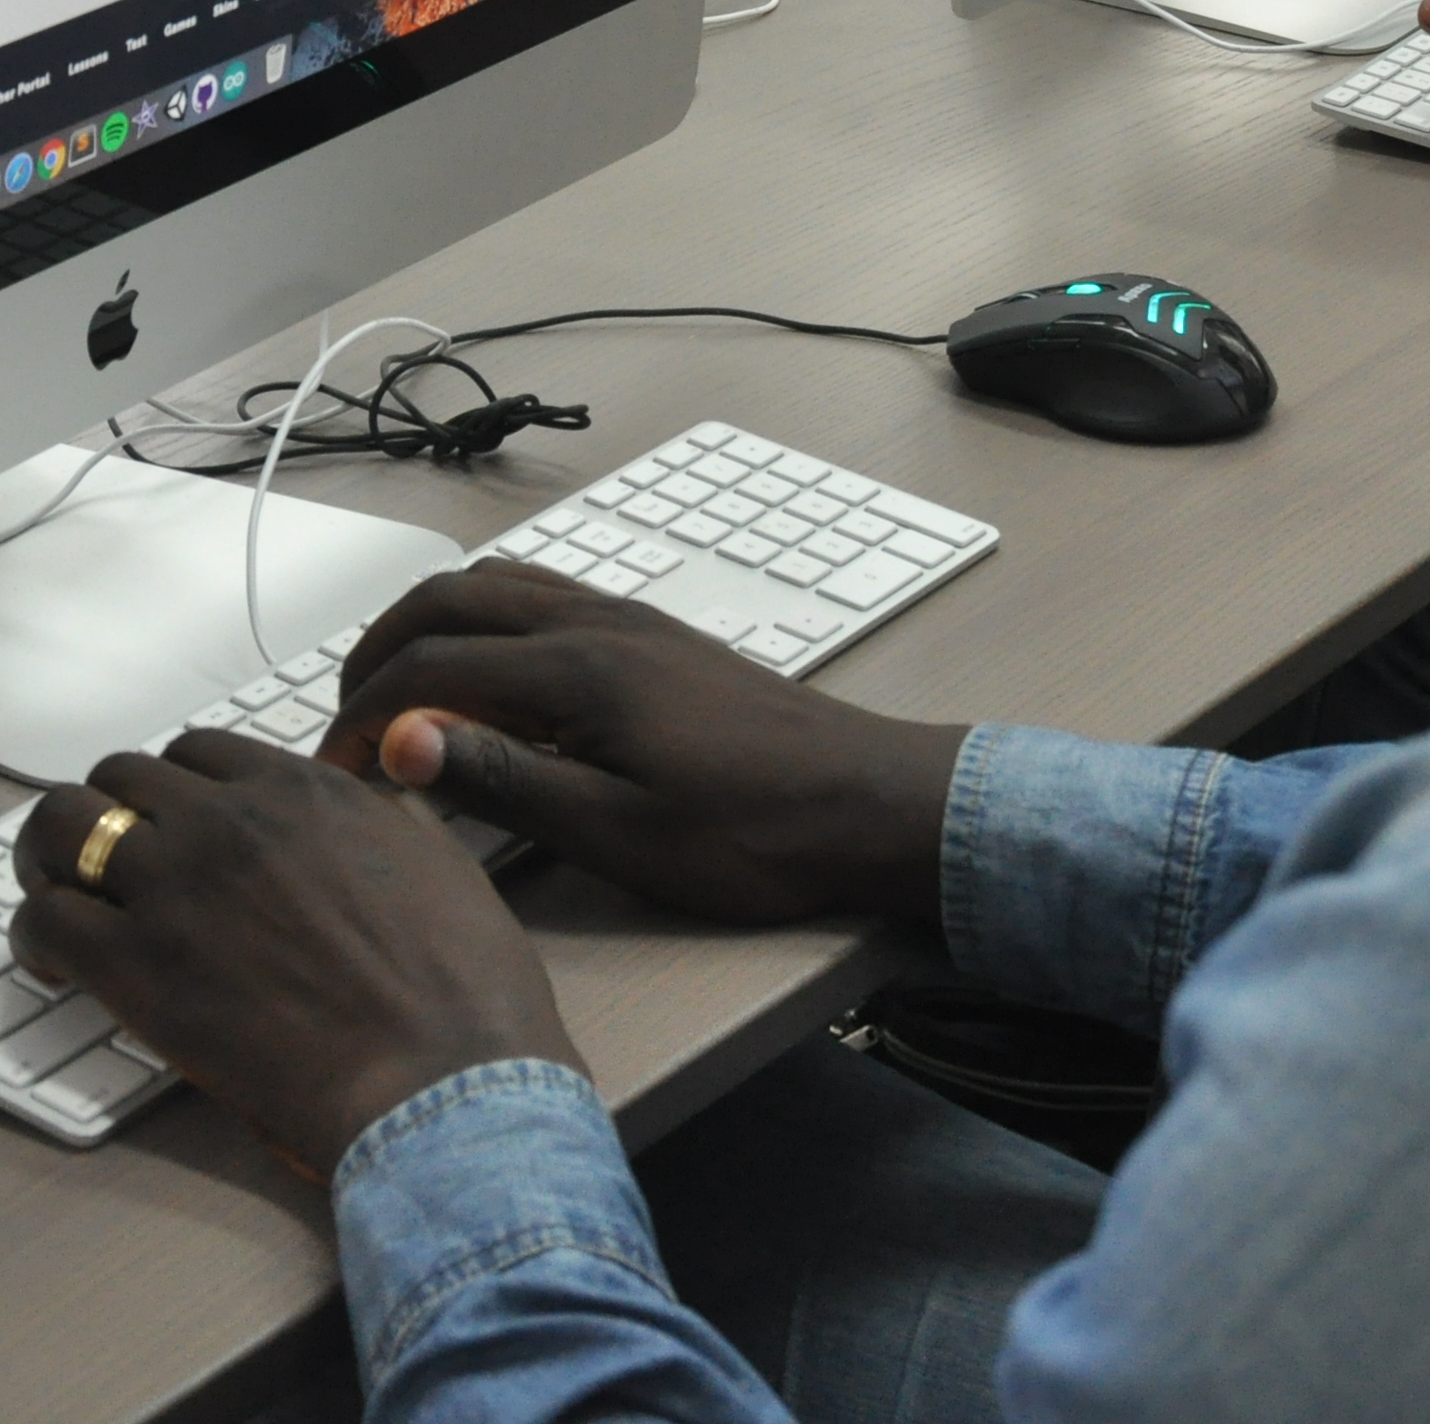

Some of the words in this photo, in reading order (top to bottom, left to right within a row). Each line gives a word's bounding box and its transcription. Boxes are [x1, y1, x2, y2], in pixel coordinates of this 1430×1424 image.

[17, 72, 51, 97] Portal
[67, 50, 109, 76] Lessons
[125, 33, 149, 53] Test
[163, 14, 198, 37] Games
